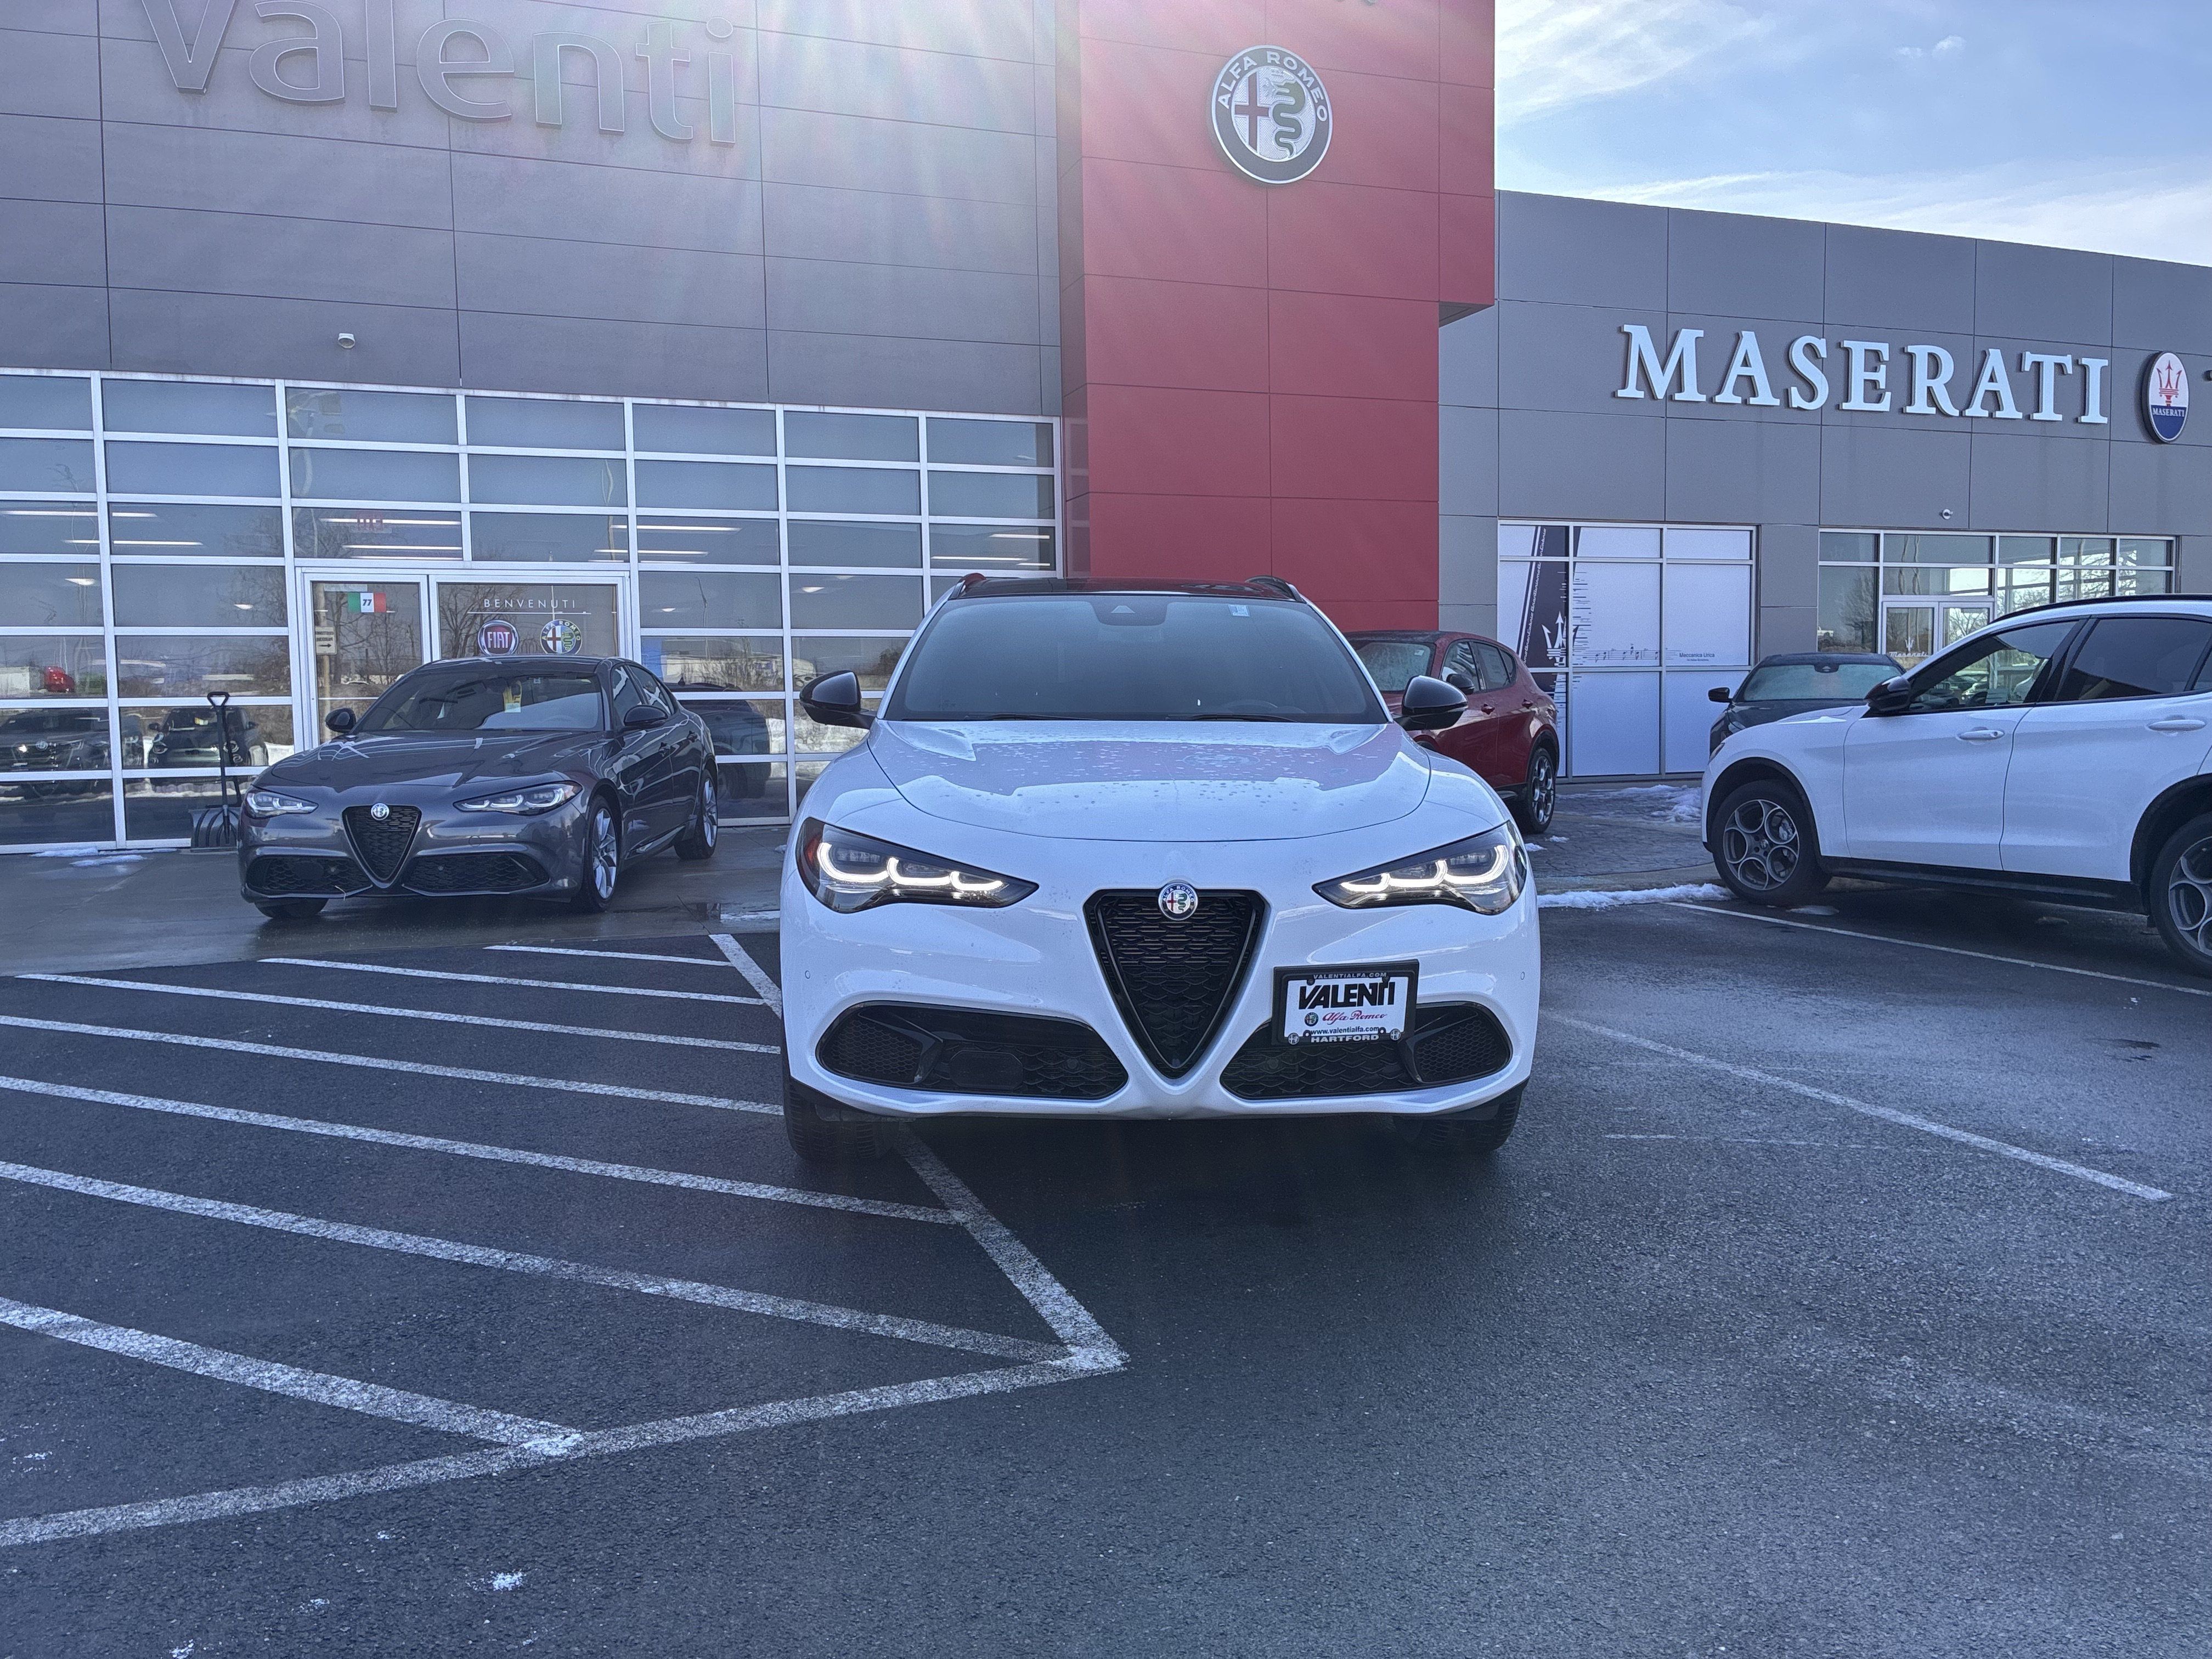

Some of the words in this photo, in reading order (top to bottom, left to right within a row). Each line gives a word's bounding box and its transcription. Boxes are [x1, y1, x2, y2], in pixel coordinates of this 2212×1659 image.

[140, 0, 736, 144] Valenti
[1218, 57, 1257, 109] ALFA
[1266, 51, 1328, 122] ROMEO
[1615, 324, 2109, 424] MASERATI
[2152, 408, 2185, 417] MASERATI
[484, 599, 575, 608] BENVENUTI
[542, 623, 555, 640] ALFA
[559, 620, 581, 641] ROMEO
[487, 631, 510, 648] FIAT
[1163, 888, 1174, 901] ALFA
[1177, 885, 1194, 902] ROMEO
[1299, 981, 1395, 1009] VALENTI
[1322, 1012, 1348, 1025] Alfa
[1350, 1010, 1387, 1020] Romeo
[1311, 1026, 1379, 1035] www.valentialfa.com
